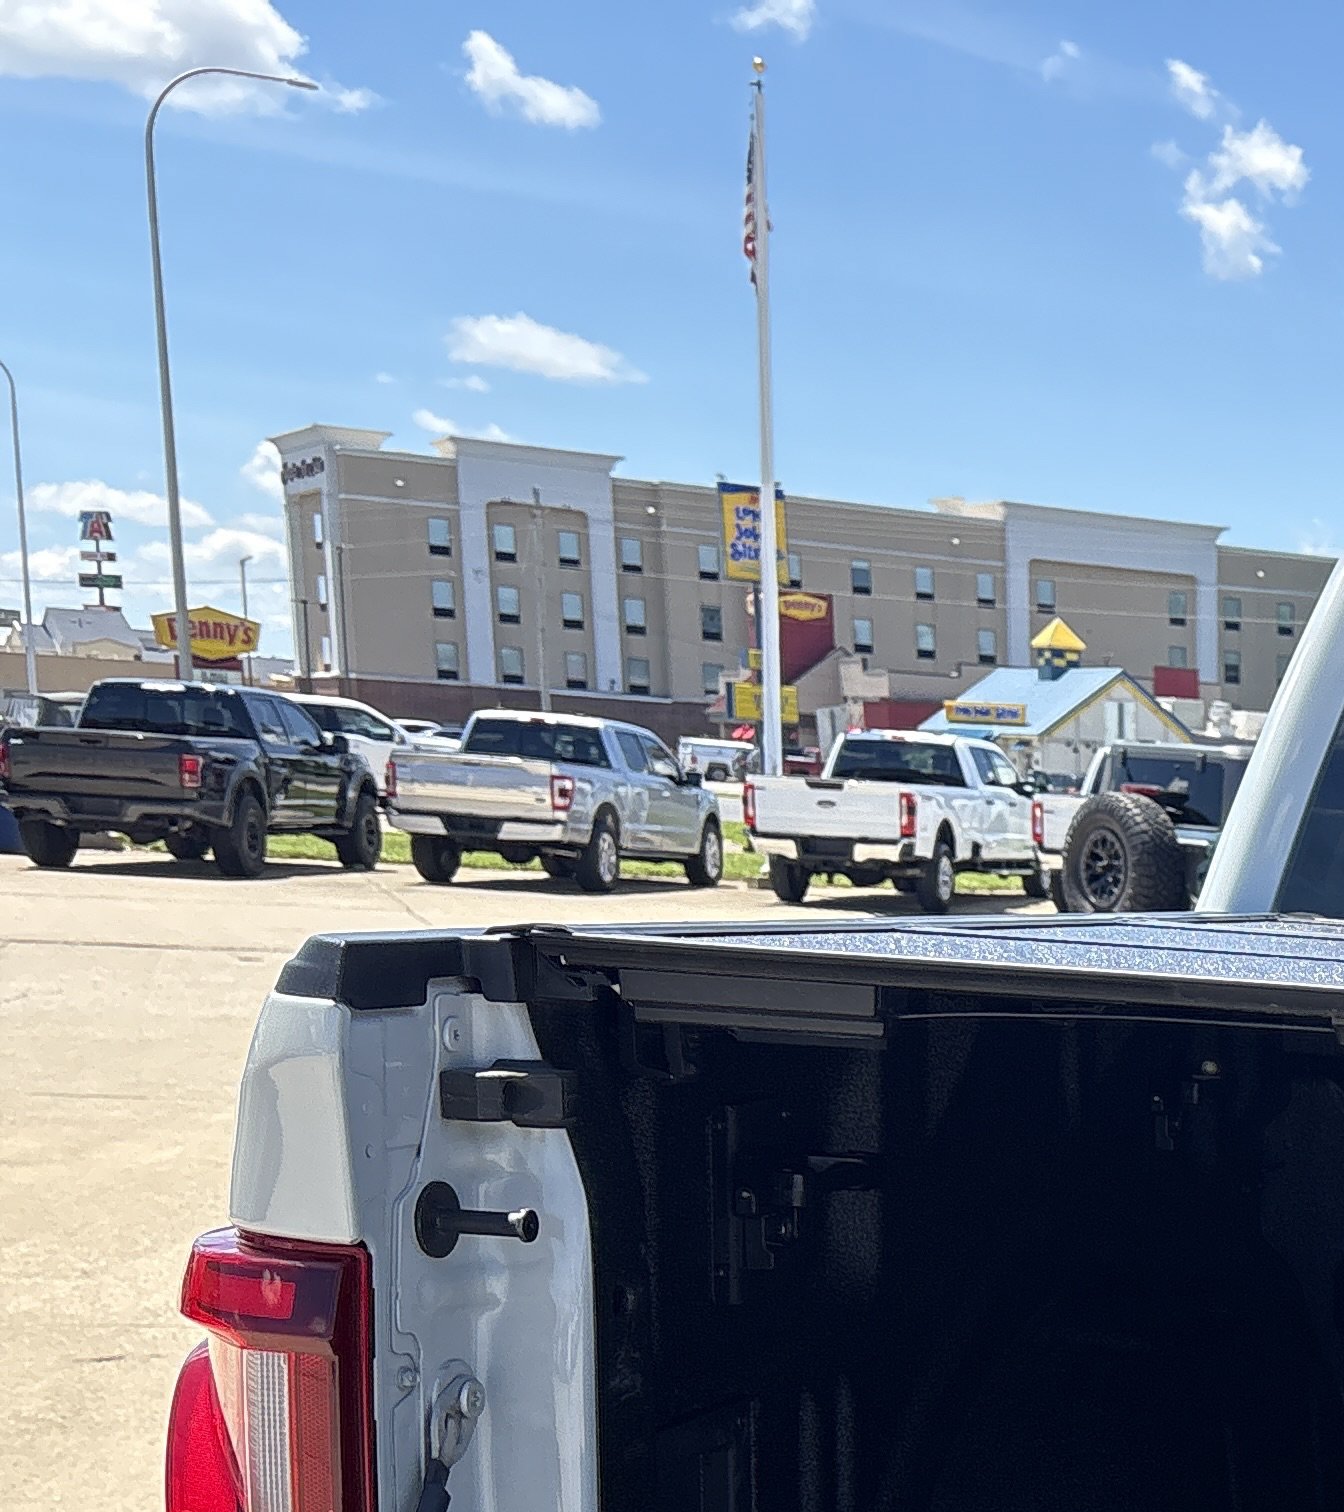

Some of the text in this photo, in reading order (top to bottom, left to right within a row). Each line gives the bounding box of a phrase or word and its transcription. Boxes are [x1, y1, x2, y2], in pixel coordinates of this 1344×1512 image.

[735, 506, 761, 522] Lon
[735, 522, 760, 541] Joh
[166, 616, 255, 646] Denny's
